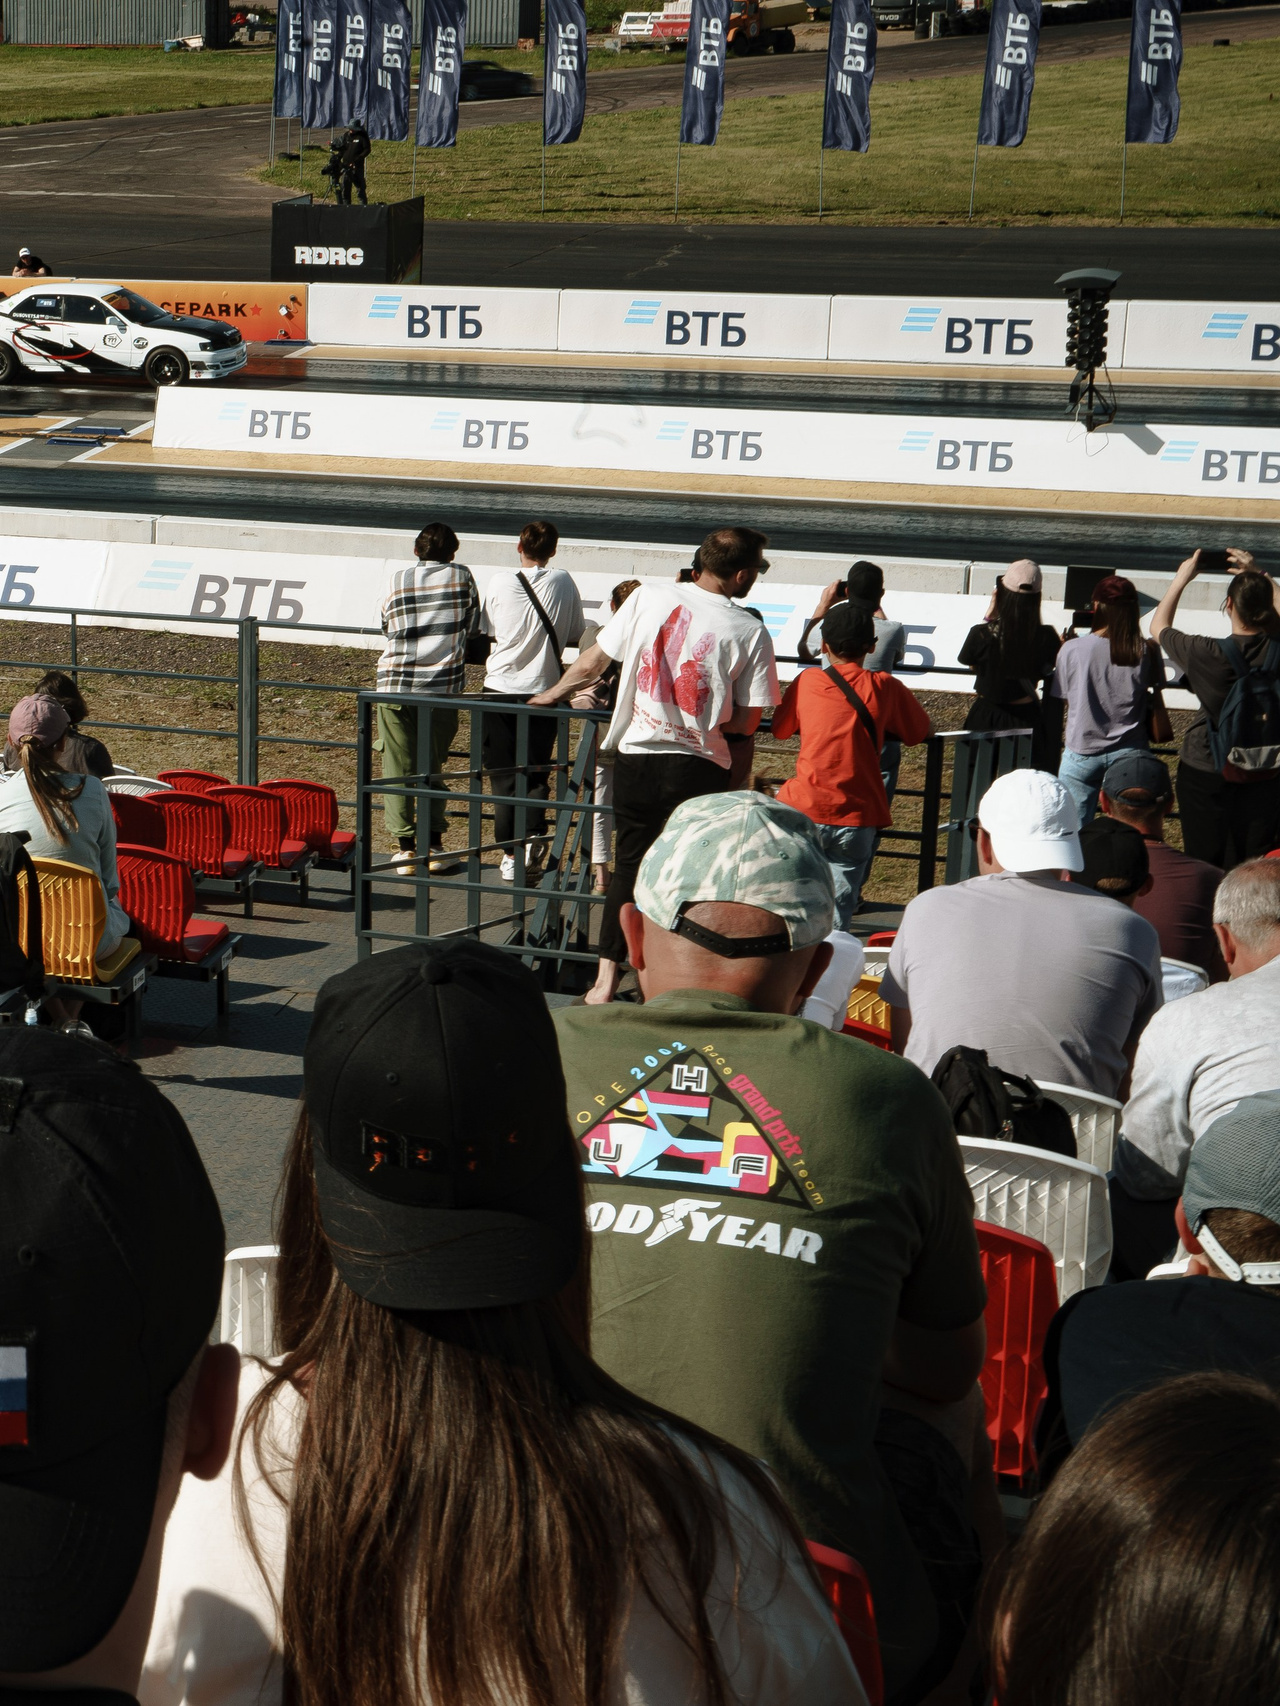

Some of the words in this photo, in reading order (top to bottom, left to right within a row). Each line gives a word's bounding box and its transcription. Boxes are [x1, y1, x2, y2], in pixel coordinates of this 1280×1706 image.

[289, 12, 301, 53] ВТБ
[313, 18, 332, 62] ВТБ
[345, 14, 365, 59] ВТБ
[382, 23, 404, 69] ВТБ
[434, 25, 457, 73] ВТБ
[557, 23, 579, 71] ВТБ
[699, 17, 722, 67] ВТБ
[843, 21, 868, 73] ВТБ
[1003, 12, 1030, 65] ВТБ
[1148, 8, 1174, 60] ВТБ
[294, 246, 364, 266] RDRC
[406, 304, 484, 340] ВТБ
[664, 310, 747, 347] ВТБ
[944, 316, 1035, 356] ВТБ
[248, 409, 312, 440] ВТБ
[462, 418, 530, 451] ВТБ
[690, 428, 763, 462] ВТБ
[936, 439, 1014, 474] ВТБ
[1201, 449, 1280, 484] ВТБ
[189, 573, 308, 624] ВТБ
[630, 1041, 687, 1080] 2002
[702, 1044, 734, 1076] Race
[727, 1073, 782, 1123] grand
[763, 1115, 803, 1160] prix
[792, 1159, 825, 1205] Team
